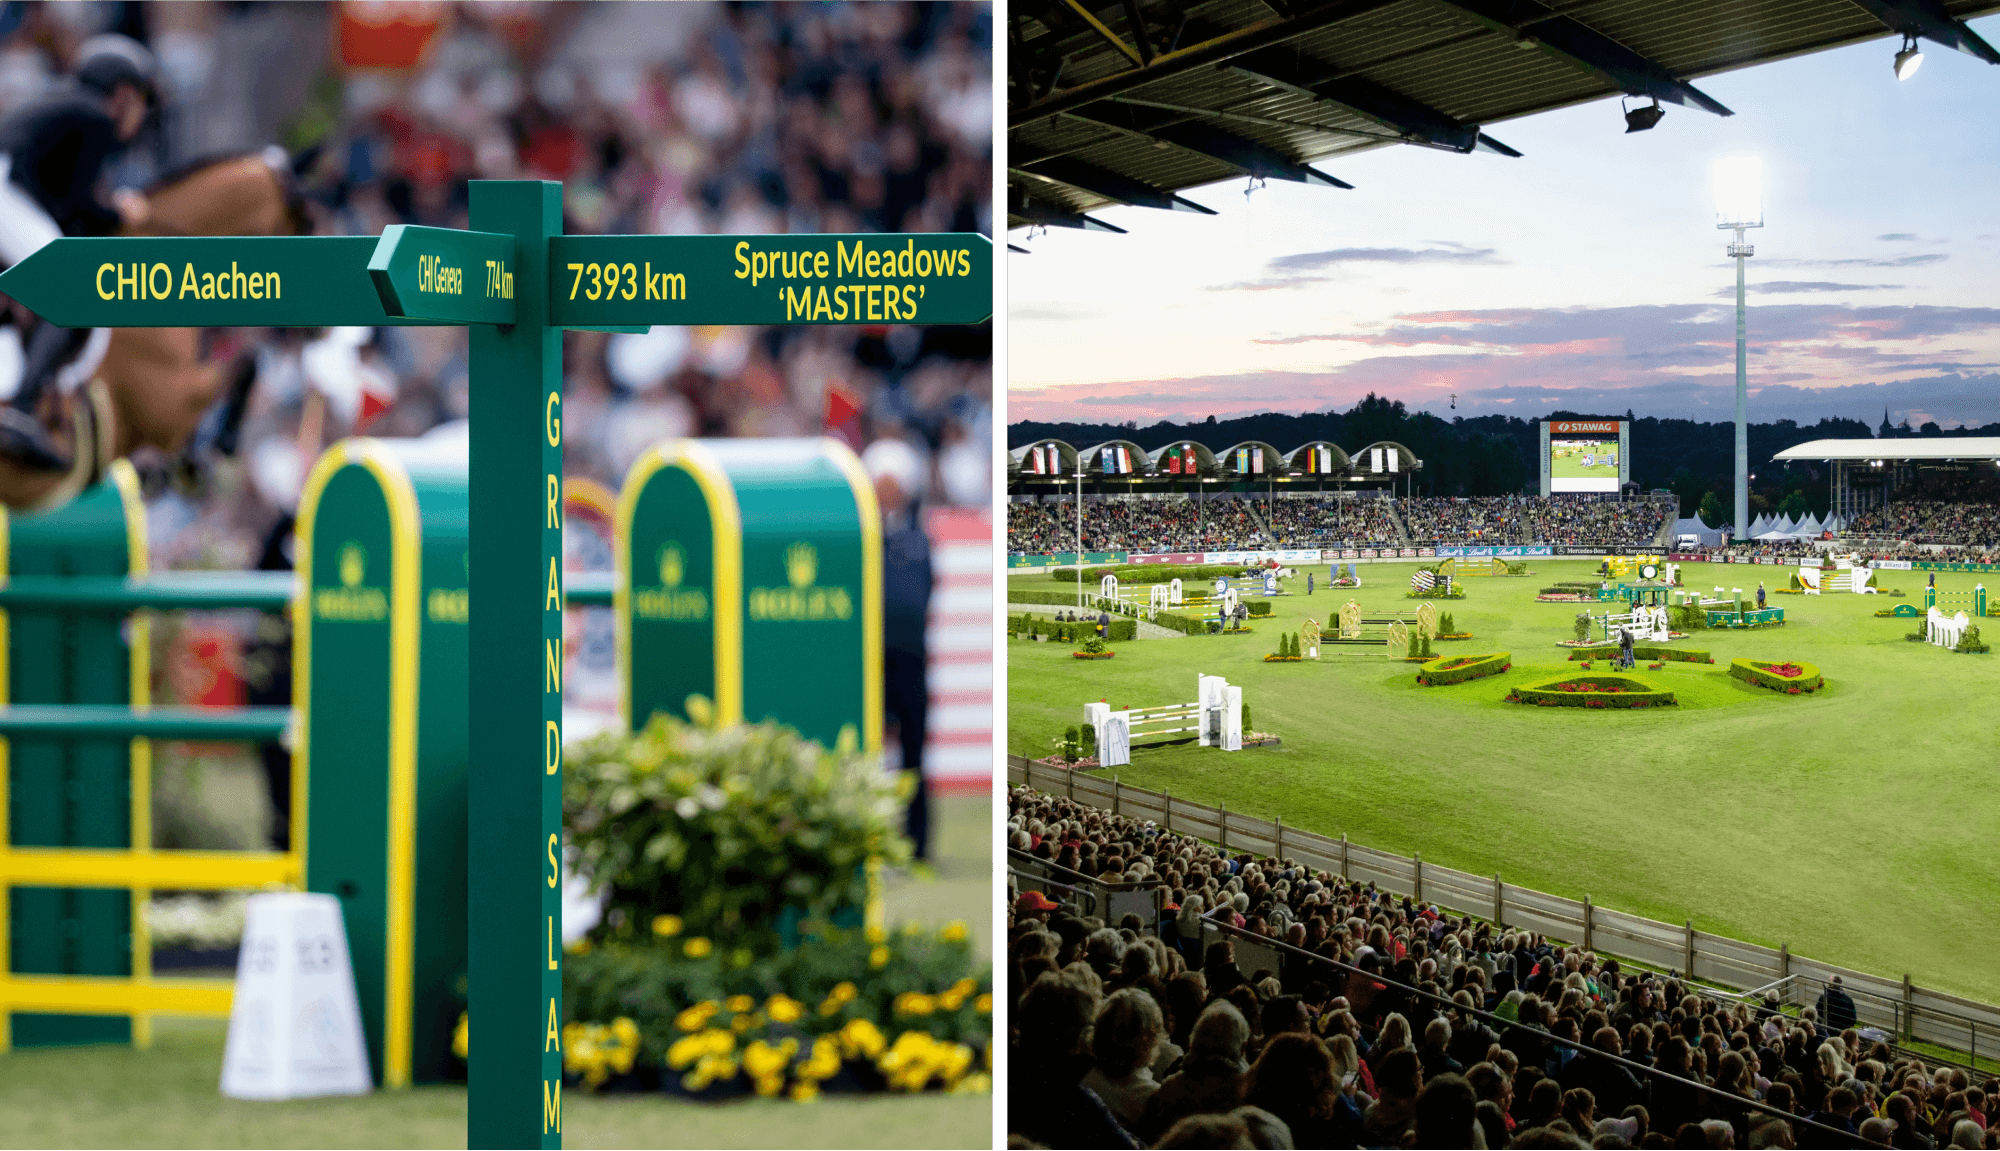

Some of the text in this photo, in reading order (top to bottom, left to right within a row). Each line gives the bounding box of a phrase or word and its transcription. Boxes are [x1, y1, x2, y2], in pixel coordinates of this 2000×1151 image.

[96, 262, 281, 301] CHIO Aachen
[418, 255, 514, 299] CHI Geneva 774 km
[567, 262, 686, 301] 7393 km
[735, 239, 971, 287] Spruce Meadows
[1571, 423, 1612, 431] STAWAG
[1438, 548, 1457, 556] Lindt
[1467, 548, 1487, 556] Lindt
[545, 392, 560, 1134] GRAND SLAM
